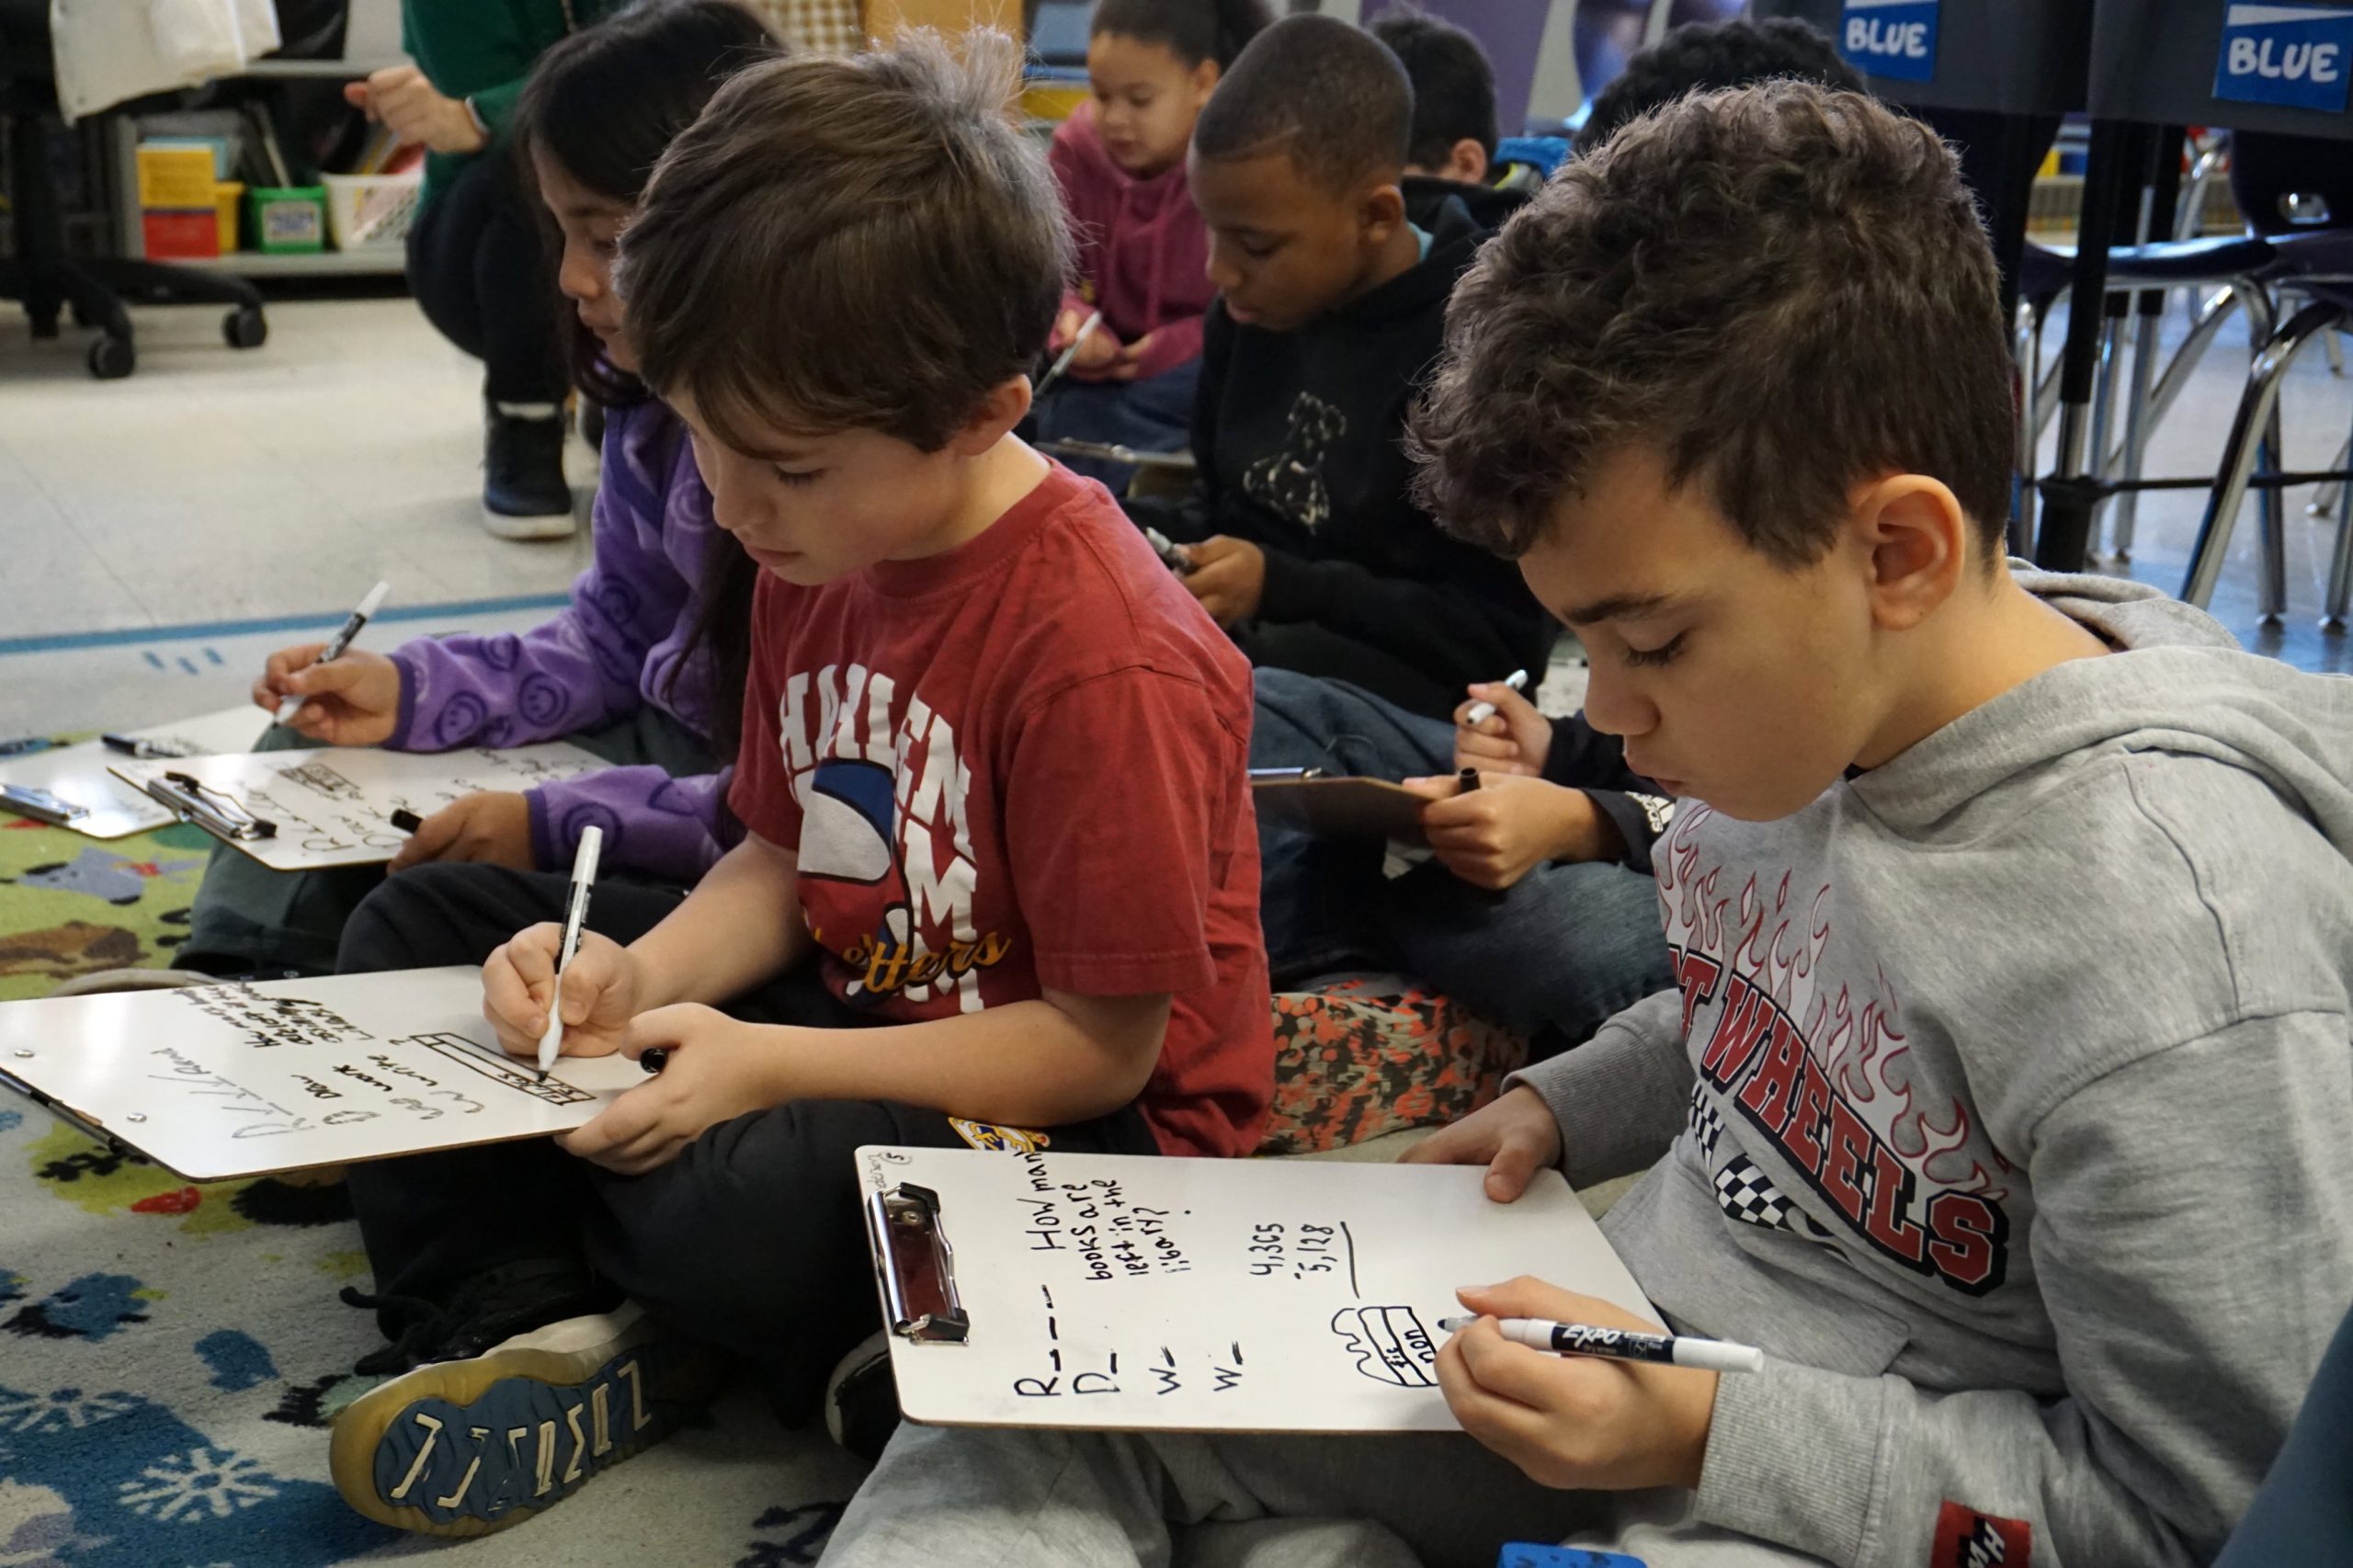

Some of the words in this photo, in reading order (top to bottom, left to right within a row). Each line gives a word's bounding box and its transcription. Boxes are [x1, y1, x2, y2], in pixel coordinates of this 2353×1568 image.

[1845, 17, 1928, 58] BLUE
[2227, 37, 2340, 83] BLUE
[1700, 970, 2009, 1298] WHEELS
[1061, 1183, 1099, 1219] are
[1090, 1179, 1126, 1208] the
[1108, 1215, 1133, 1232] in
[1070, 1225, 1113, 1280] books
[1110, 1240, 1150, 1276] left
[1563, 1324, 1621, 1348] EXPO
